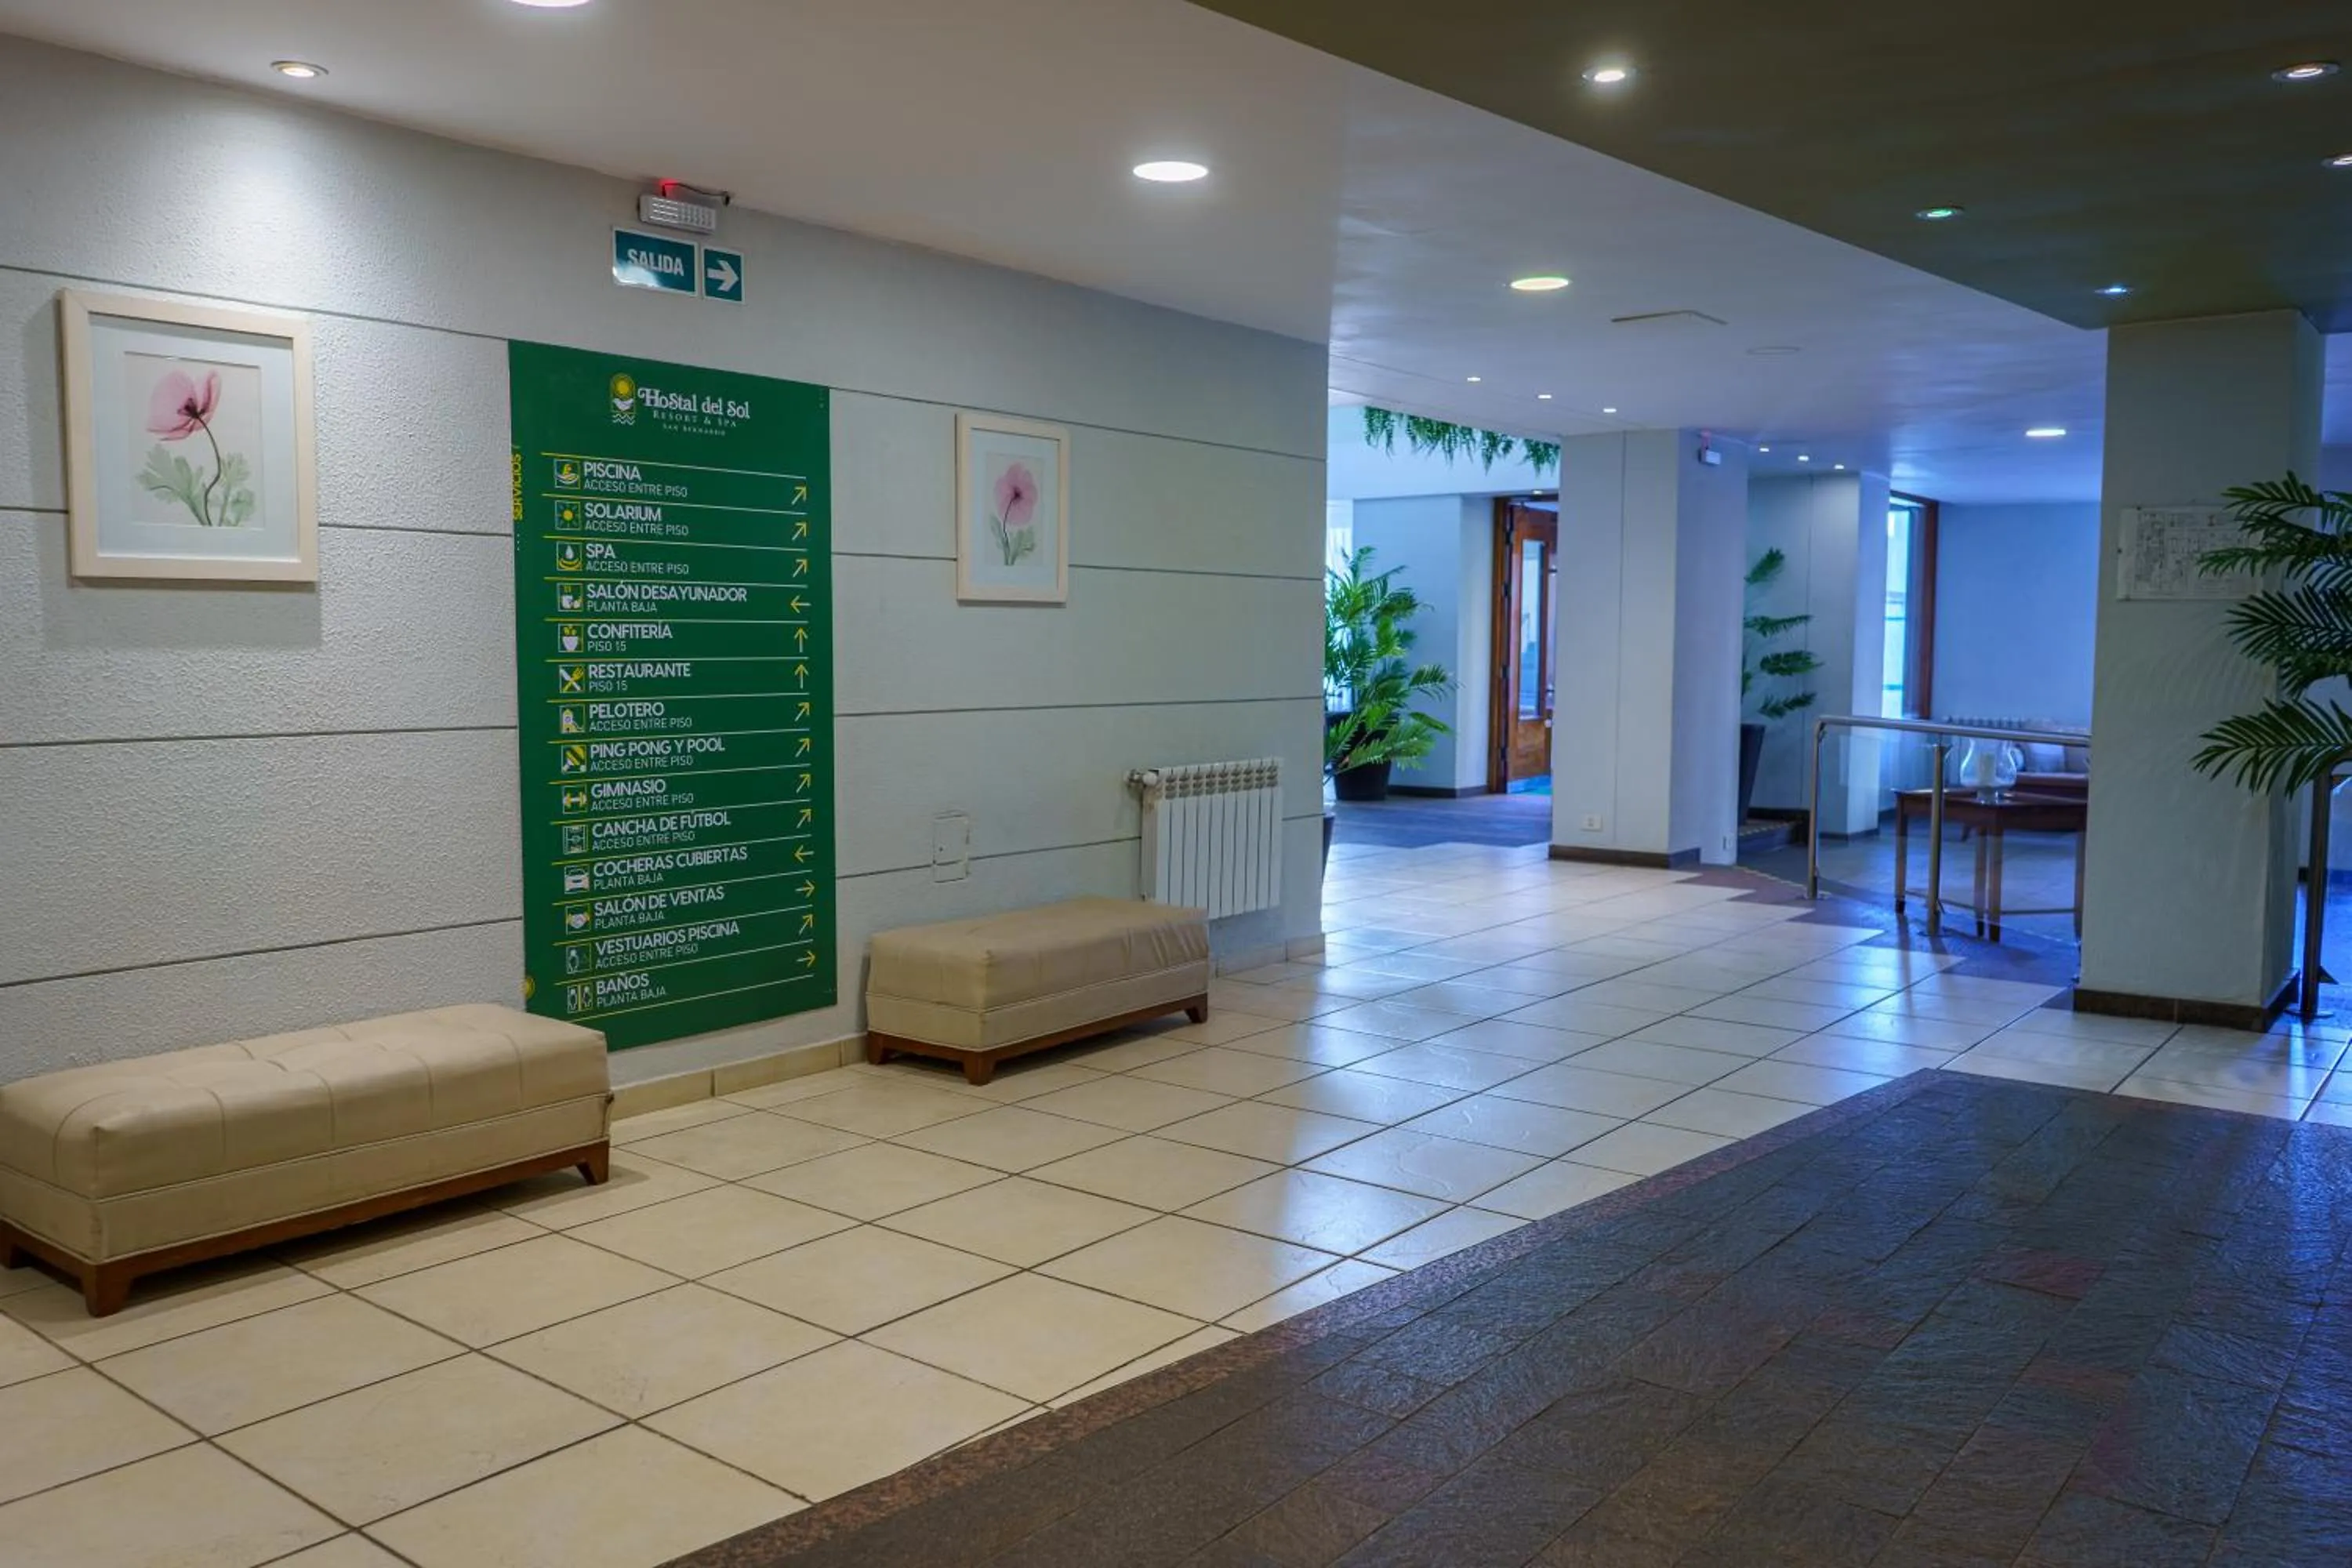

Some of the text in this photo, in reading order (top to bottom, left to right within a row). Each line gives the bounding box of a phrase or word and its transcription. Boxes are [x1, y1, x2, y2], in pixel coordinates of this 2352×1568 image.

[628, 249, 684, 276] SALIDA
[702, 396, 723, 415] del
[728, 401, 750, 419] Sol
[584, 463, 641, 481] PISCINA
[512, 453, 522, 521] SERVICIOS
[583, 479, 687, 498] ACCESO ENTRE PISO
[585, 503, 662, 521] SOLARIUM
[585, 520, 688, 536] ACCESO ENTRE PISO
[586, 543, 616, 559] SPA
[586, 561, 689, 575] ACCESO ENTRE PISO
[586, 580, 747, 602] SALÓN DESAYUNADOR
[587, 601, 658, 612] PLANTA BAJA
[588, 620, 673, 639] CONFITERÍA
[588, 641, 626, 652] PISO 15
[589, 662, 691, 678] RESTAURANTE
[590, 681, 627, 691] PISO 15
[590, 702, 665, 718] PELOTERO
[590, 717, 692, 731] ACCESO ENTRE PISO
[590, 737, 725, 758] PING PONG Y POOL
[590, 755, 693, 771] ACCESO ENTRE PISO
[591, 779, 666, 798] GIMNASIO
[591, 793, 694, 811] ACCESO ENTRE PISO
[592, 810, 731, 837] CANCHA DE FÚTBOL
[592, 831, 695, 851] ACCESO ENTRE PISO
[593, 847, 747, 877] COCHERAS CUBIERTAS
[594, 873, 664, 890] PLANTA BAJA
[594, 886, 724, 916] SALÓN DE VENTAS
[595, 910, 665, 929] PLANTA BAJA
[595, 921, 740, 956] VESTUARIOS PISCINA
[596, 943, 699, 969] ACCESO ENTRE PISO
[597, 972, 649, 995] BAÑOS
[597, 986, 666, 1007] PLANTA BAJA
